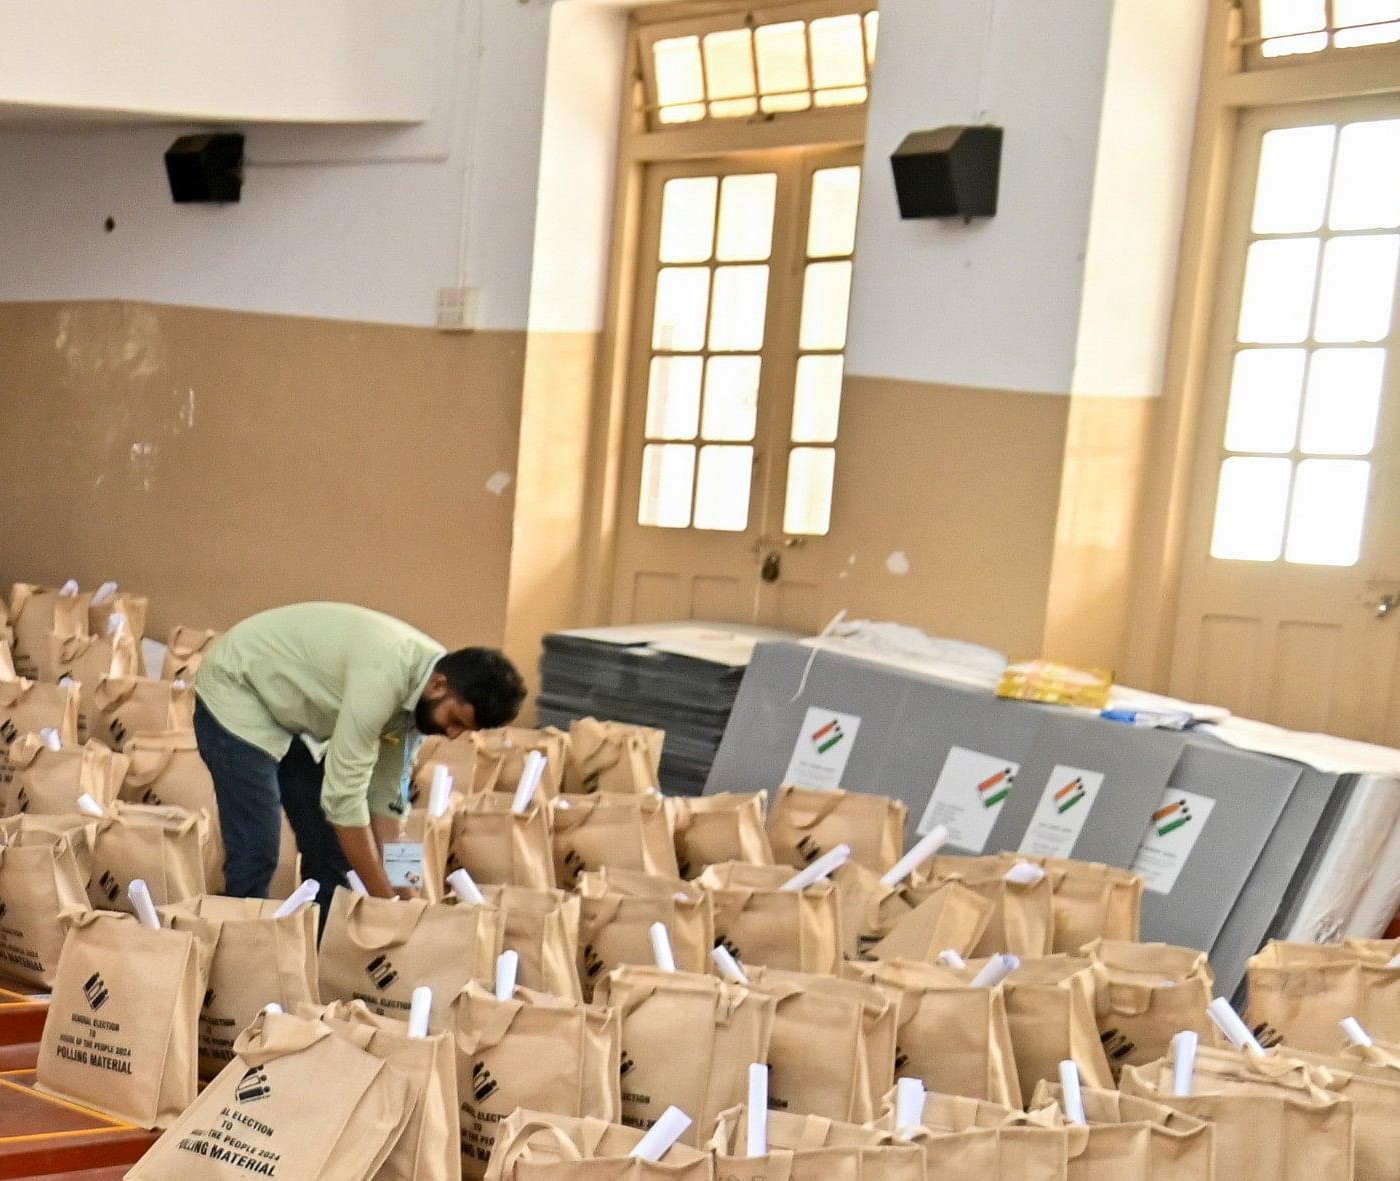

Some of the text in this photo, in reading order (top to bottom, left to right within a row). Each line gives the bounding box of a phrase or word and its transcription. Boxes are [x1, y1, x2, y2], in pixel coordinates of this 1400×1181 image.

[56, 1044, 133, 1076] POLLING MATERIAL
[220, 1119, 234, 1132] TO
[230, 1110, 275, 1138] ELECTION
[209, 1145, 276, 1178] MATERIAL
[223, 1133, 256, 1155] PEOPLE
[257, 1148, 281, 1162] 2024
